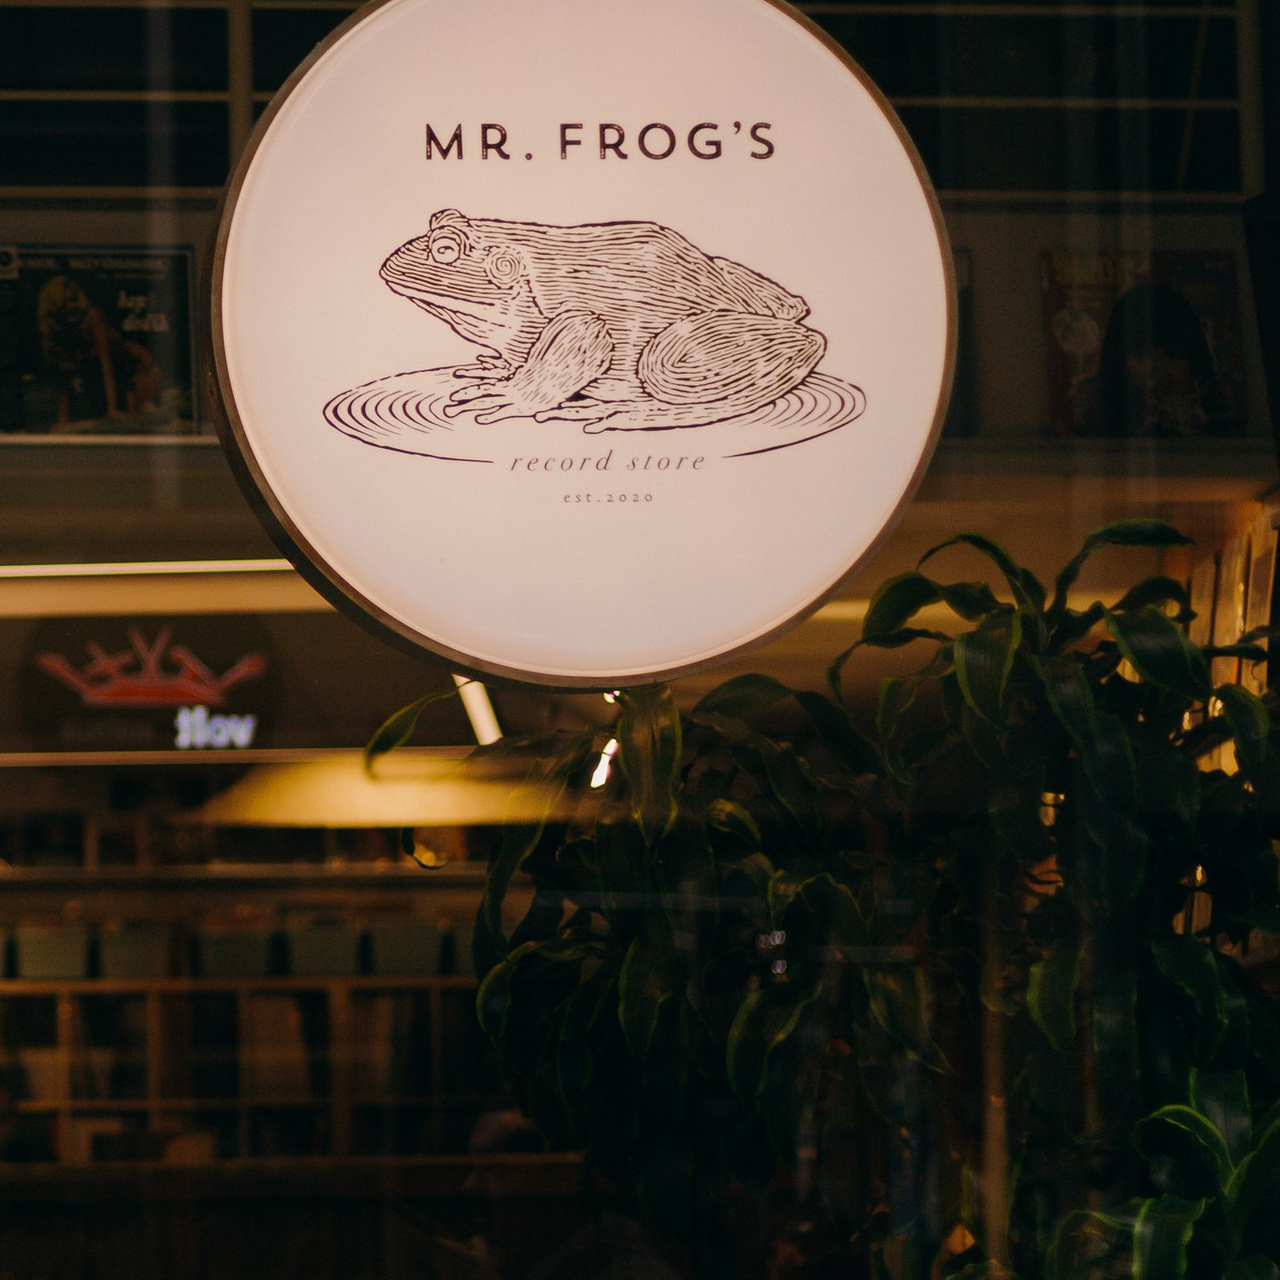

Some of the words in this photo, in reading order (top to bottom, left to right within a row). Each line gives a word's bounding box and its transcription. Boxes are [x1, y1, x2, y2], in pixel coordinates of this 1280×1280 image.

[424, 122, 533, 161] MR.
[559, 121, 776, 160] FROG'S
[510, 449, 613, 473] record
[626, 451, 707, 472] store
